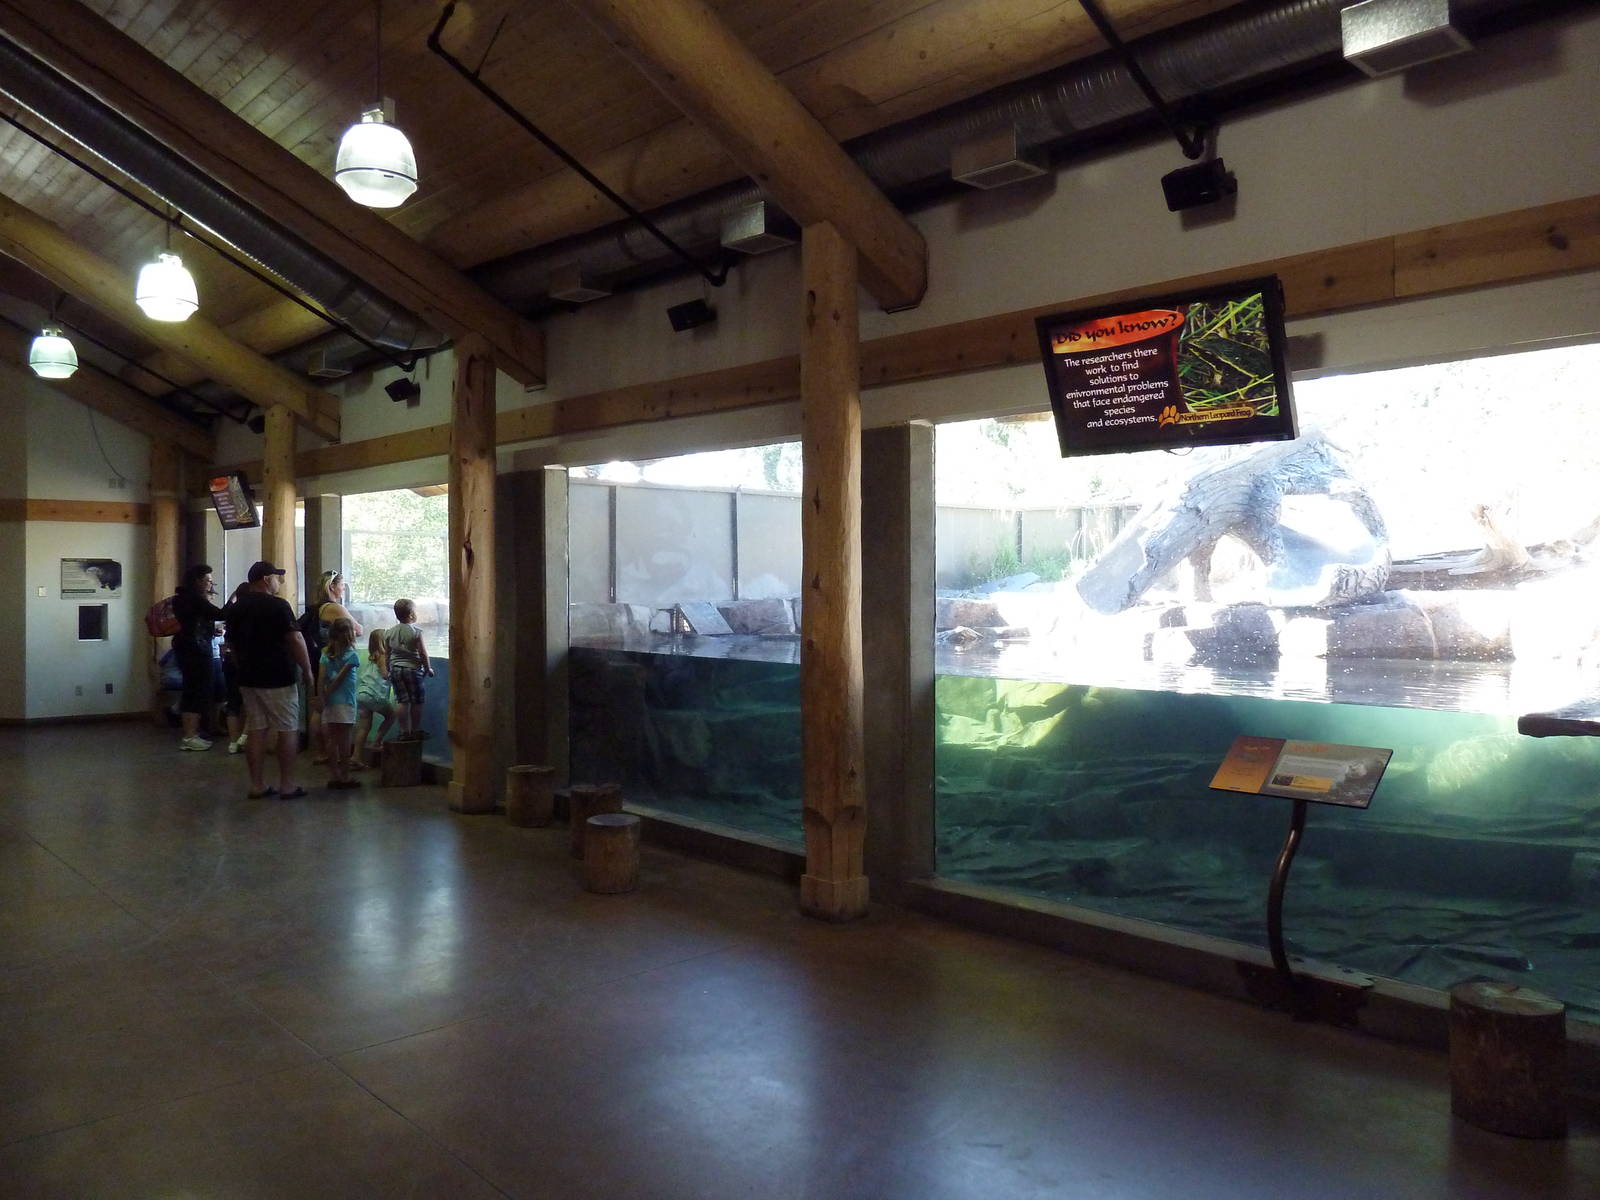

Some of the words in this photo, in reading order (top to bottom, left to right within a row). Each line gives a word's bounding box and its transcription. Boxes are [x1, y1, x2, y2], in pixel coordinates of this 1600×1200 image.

[1085, 327, 1115, 342] you
[1118, 313, 1178, 334] know?
[1064, 358, 1080, 368] The
[1081, 351, 1132, 365] researchers
[1133, 348, 1158, 358] there
[1085, 365, 1107, 375] work
[1110, 364, 1120, 372] to
[1121, 359, 1139, 372] find
[1089, 374, 1128, 386] solutions
[1129, 373, 1139, 381] to
[1127, 380, 1169, 393] problems
[1073, 400, 1091, 409] that
[1092, 398, 1110, 407] face
[1112, 390, 1165, 404] endangered
[1103, 405, 1136, 417] species
[1086, 418, 1103, 428] and
[1104, 415, 1158, 427] ecosystems.
